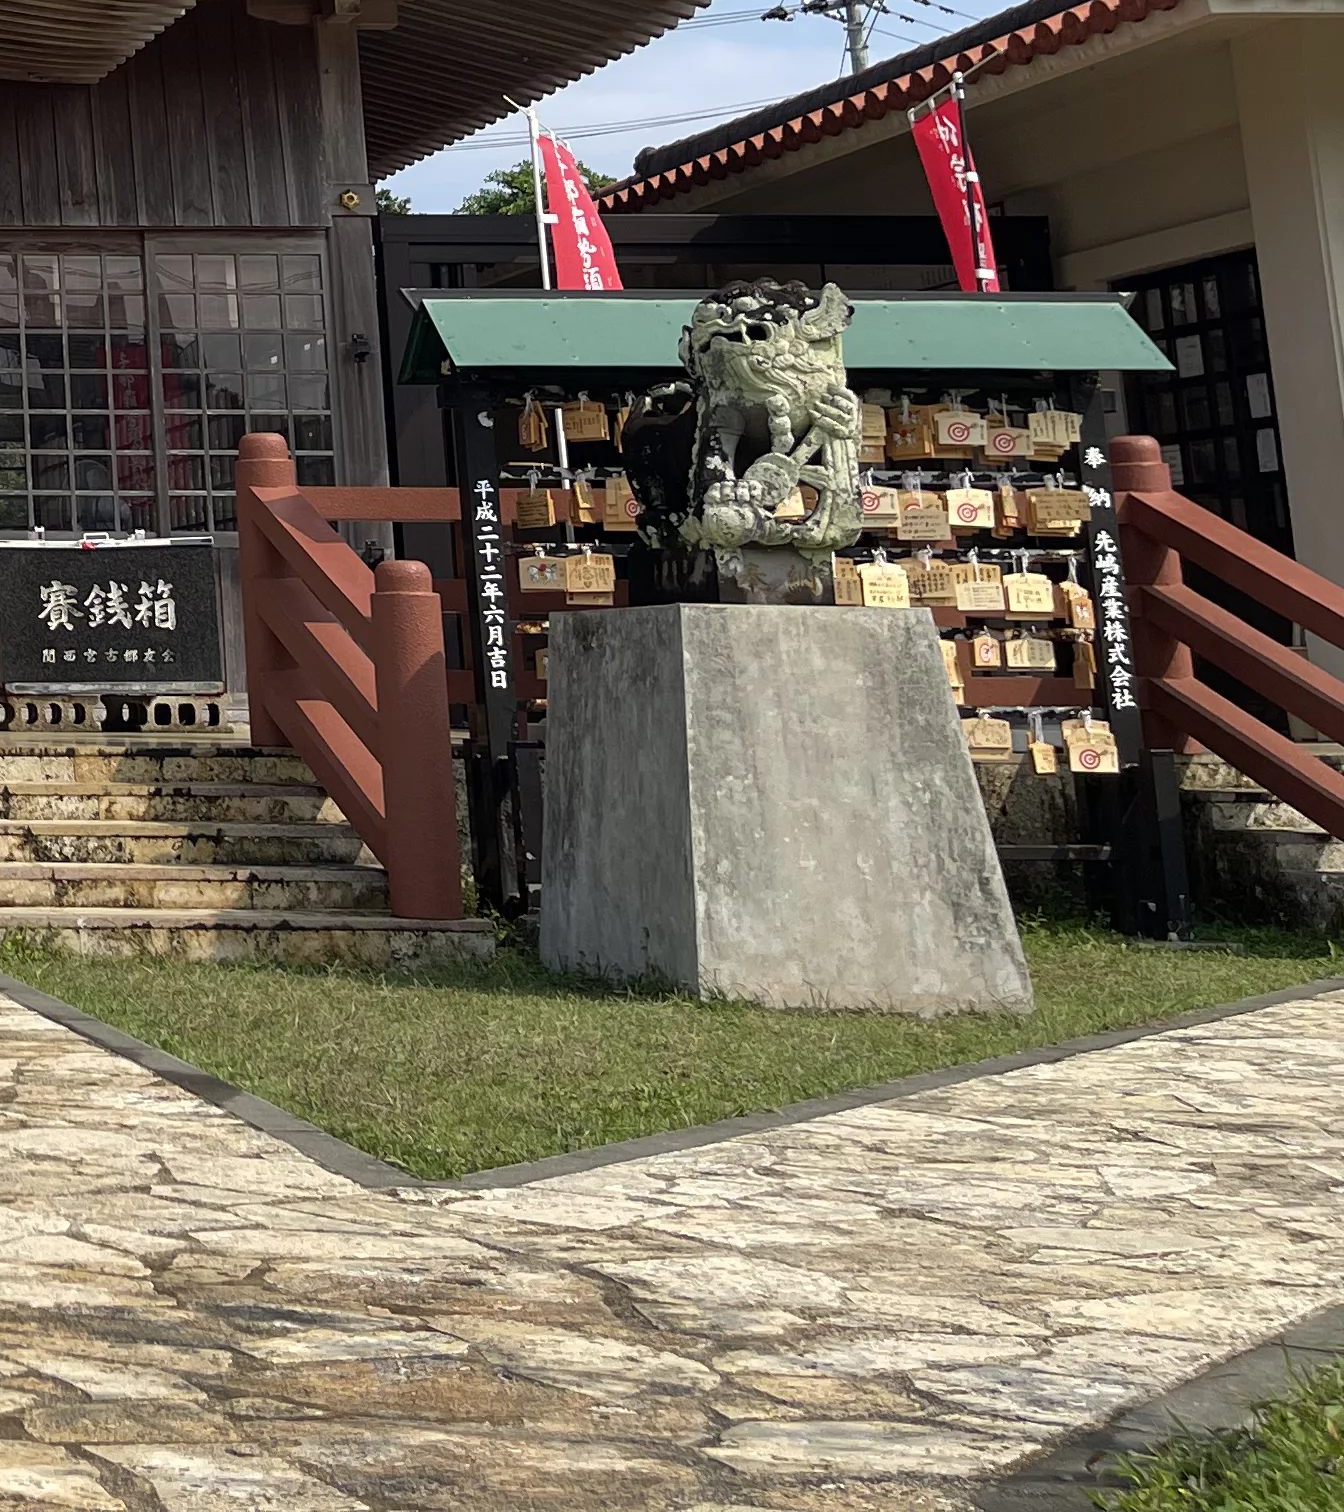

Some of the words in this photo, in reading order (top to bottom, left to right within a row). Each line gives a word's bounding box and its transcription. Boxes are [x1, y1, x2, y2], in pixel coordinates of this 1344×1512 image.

[1084, 446, 1112, 509] 奉納
[38, 579, 177, 631] 賽銭箱
[473, 479, 508, 689] 平成二十二年六月吉日
[1094, 530, 1137, 710] 先嶋産業株式会社
